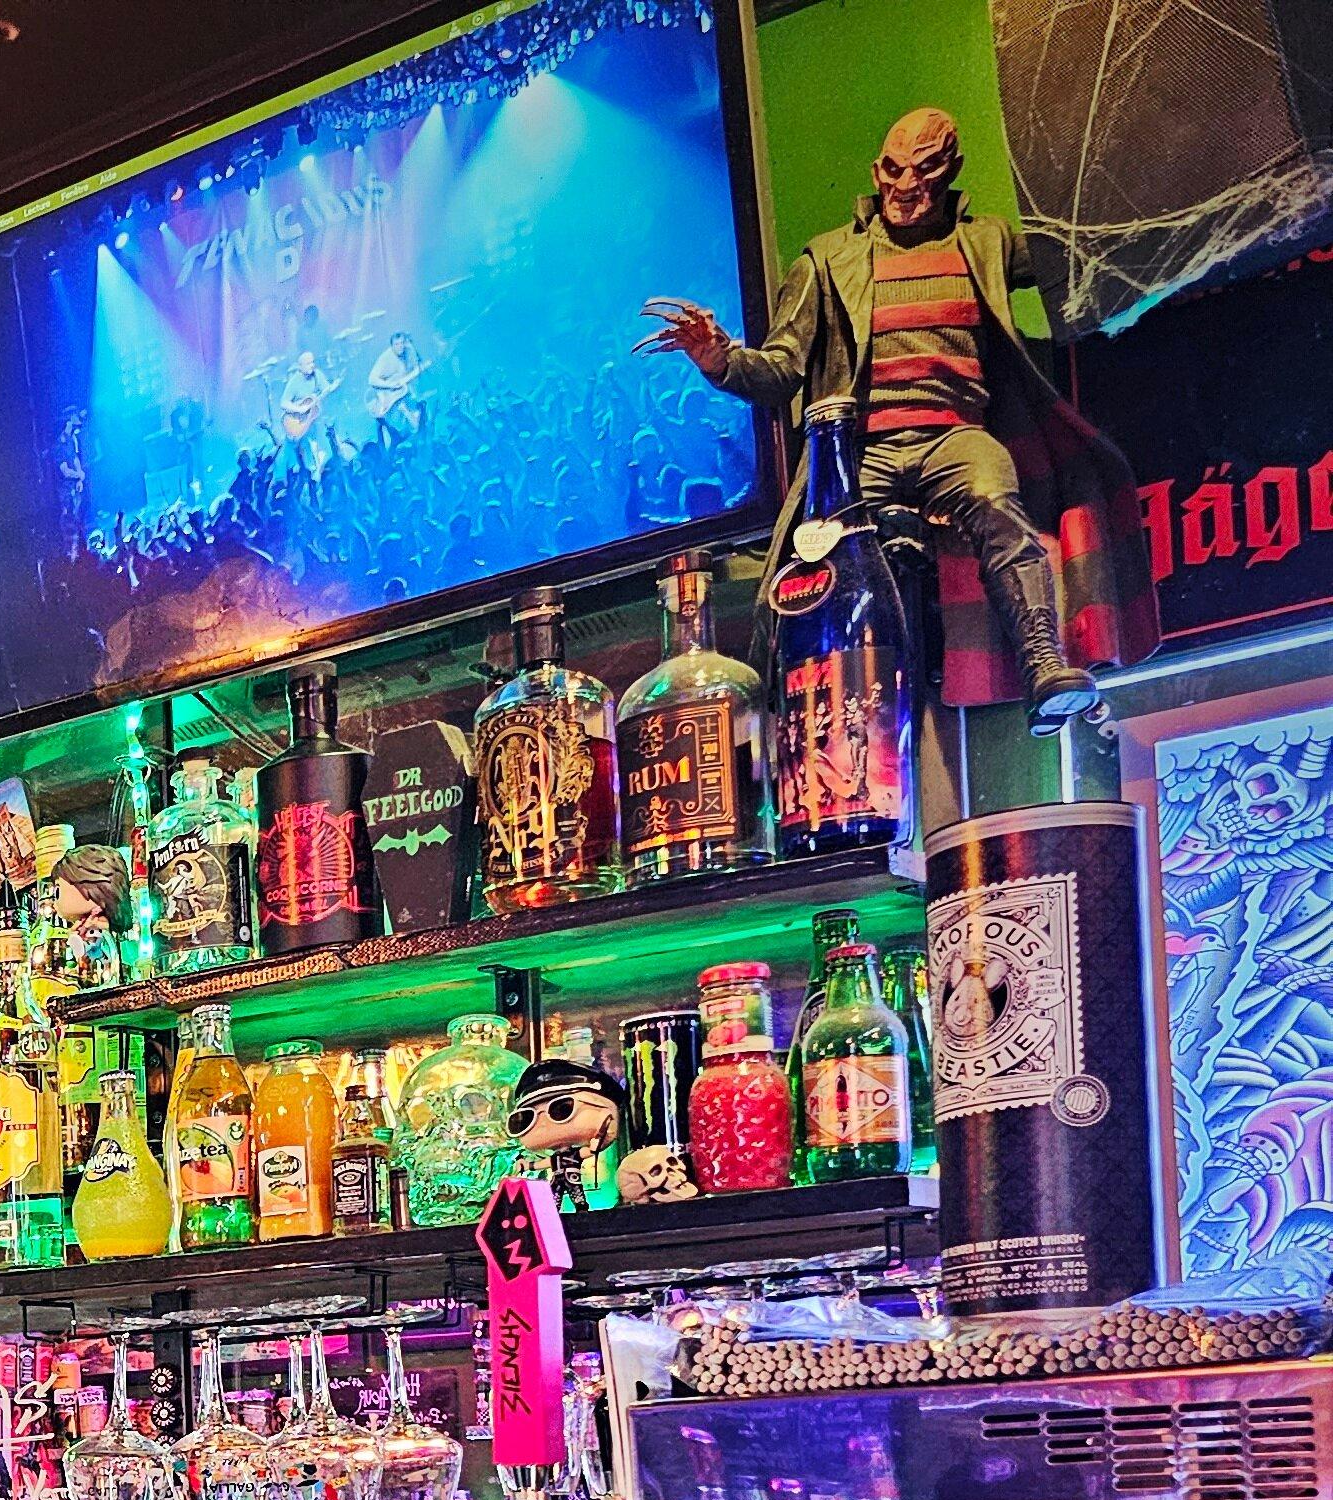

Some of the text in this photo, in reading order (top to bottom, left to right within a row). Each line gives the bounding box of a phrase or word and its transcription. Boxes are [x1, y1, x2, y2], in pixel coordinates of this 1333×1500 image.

[23, 200, 51, 217] Lecture
[61, 183, 89, 202] Fenêtre
[99, 172, 117, 186] Aide
[396, 766, 423, 789] DR
[629, 755, 691, 796] RUM
[363, 785, 463, 827] FEELGOOD
[938, 1029, 1033, 1078] BEASTIE
[976, 1233, 1080, 1255] MALT SCOTCH WHISKY
[1018, 1245, 1083, 1256] COLOURING
[1061, 1260, 1088, 1269] REAL
